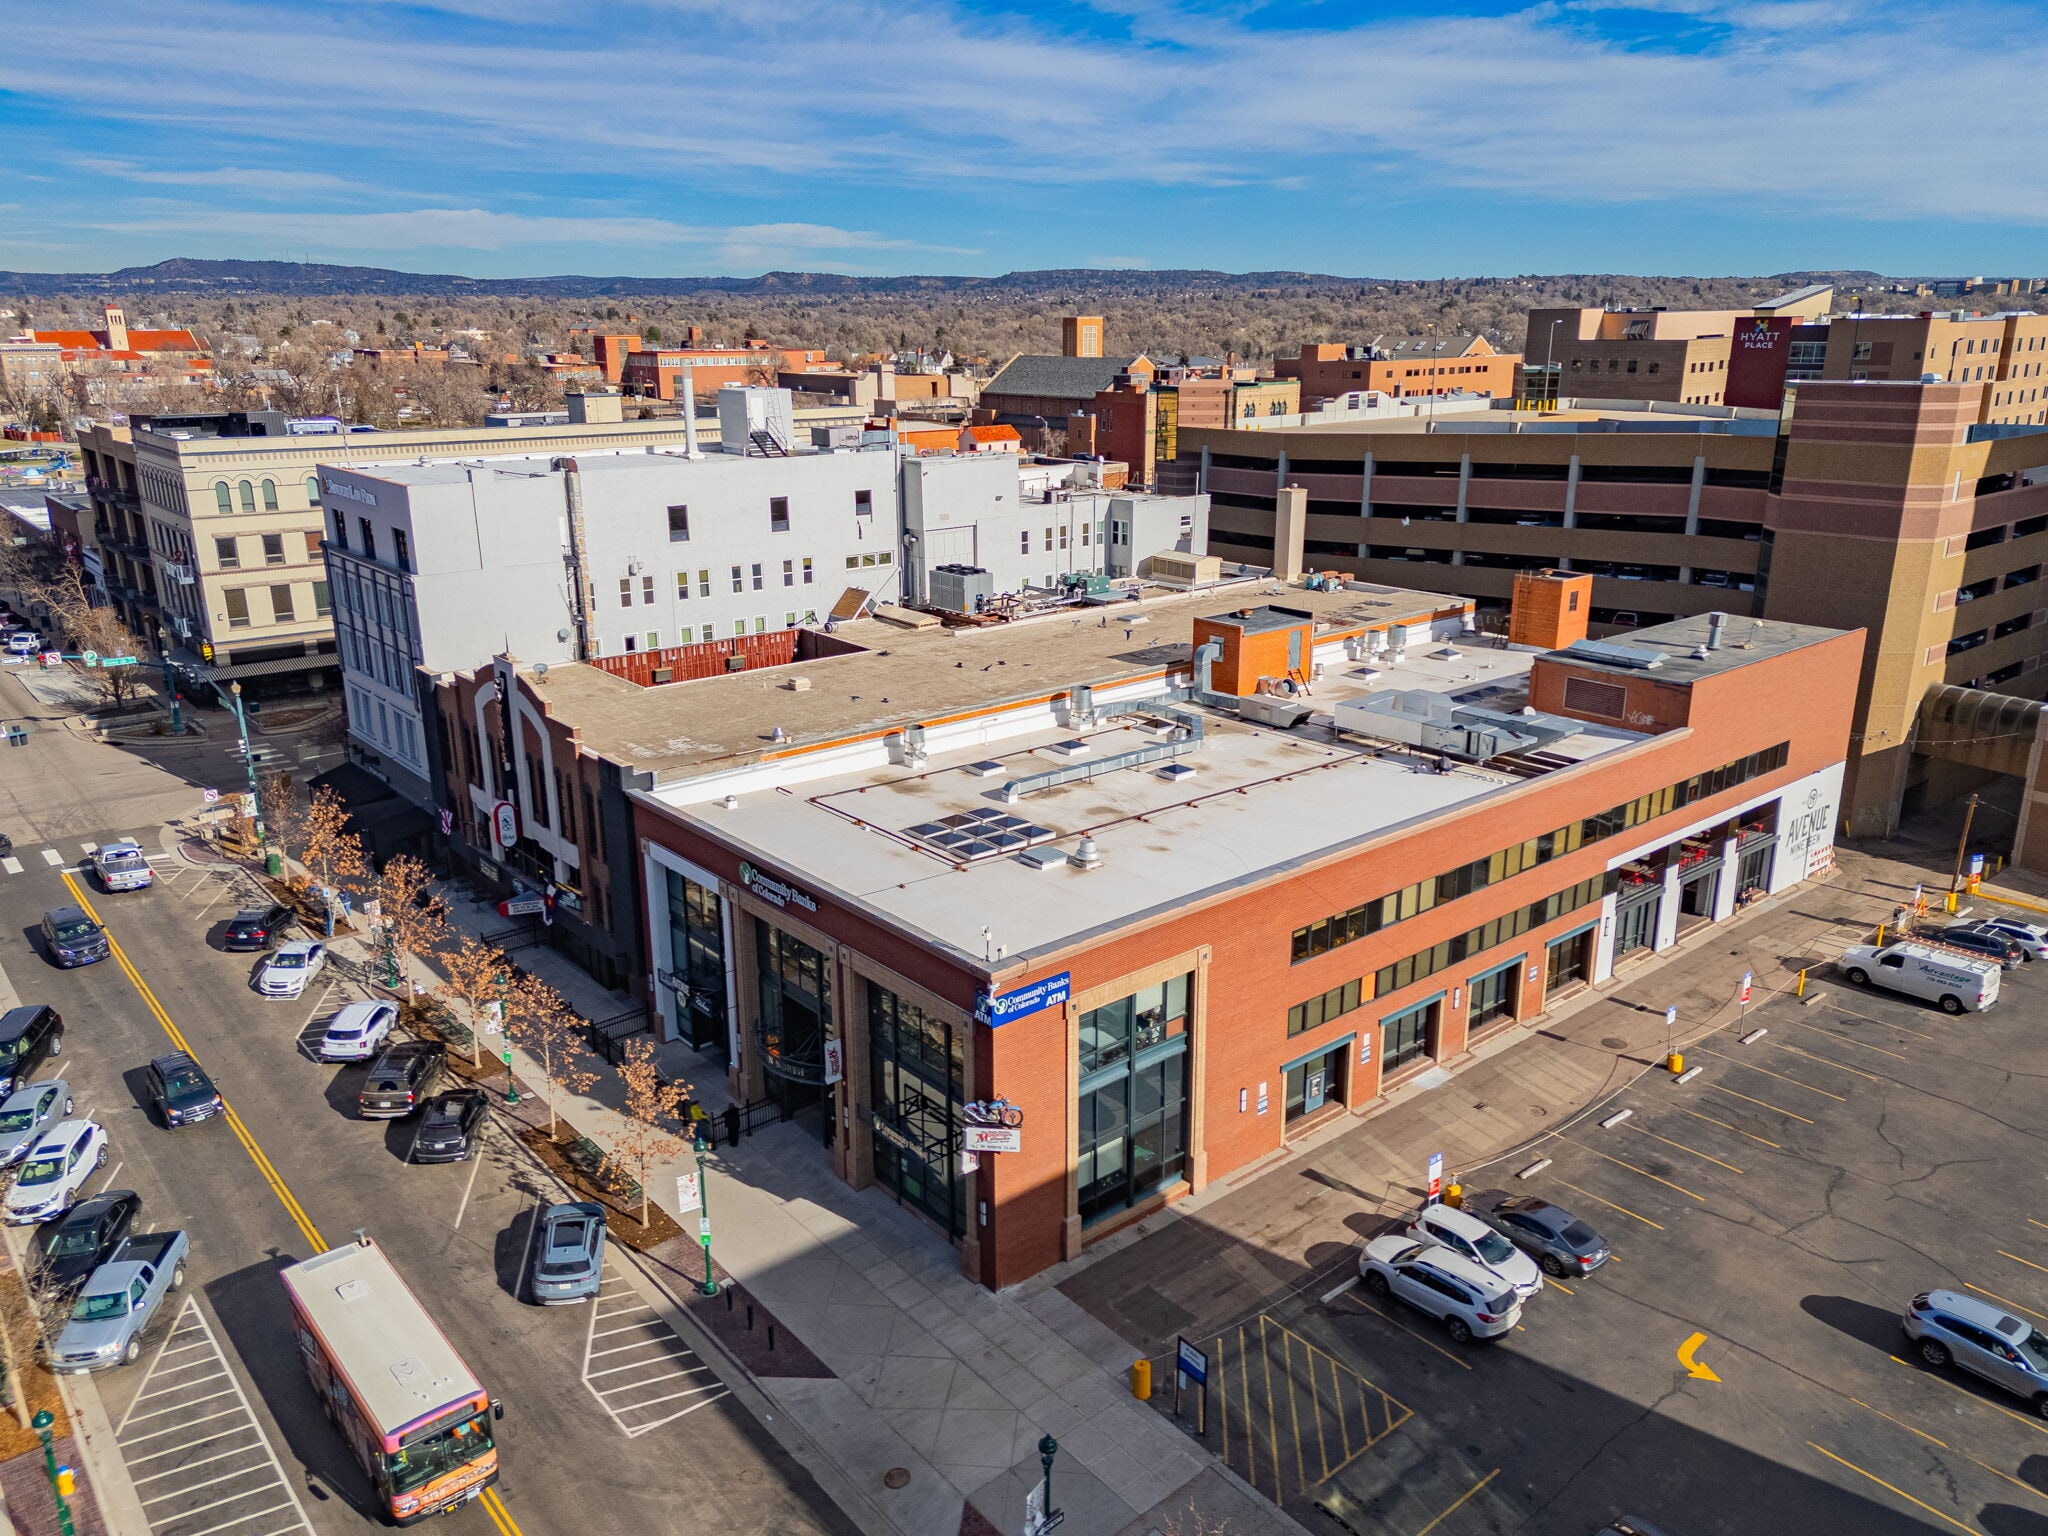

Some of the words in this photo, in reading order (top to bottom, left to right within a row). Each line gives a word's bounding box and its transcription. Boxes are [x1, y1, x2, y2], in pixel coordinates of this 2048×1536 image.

[1740, 332, 1780, 341] HYATT
[1744, 341, 1774, 349] PLACE
[1786, 804, 1831, 848] AVENUE
[751, 868, 792, 902] Community
[791, 888, 817, 912] Banks
[758, 885, 785, 907] Colorado
[1919, 964, 1972, 983] Advantage
[1007, 985, 1047, 1006] Community
[1047, 977, 1070, 992] Banks
[1045, 990, 1067, 1007] ATM
[1007, 1006, 1016, 1014] of
[1014, 996, 1041, 1011] Colorado
[974, 1009, 992, 1026] ATM
